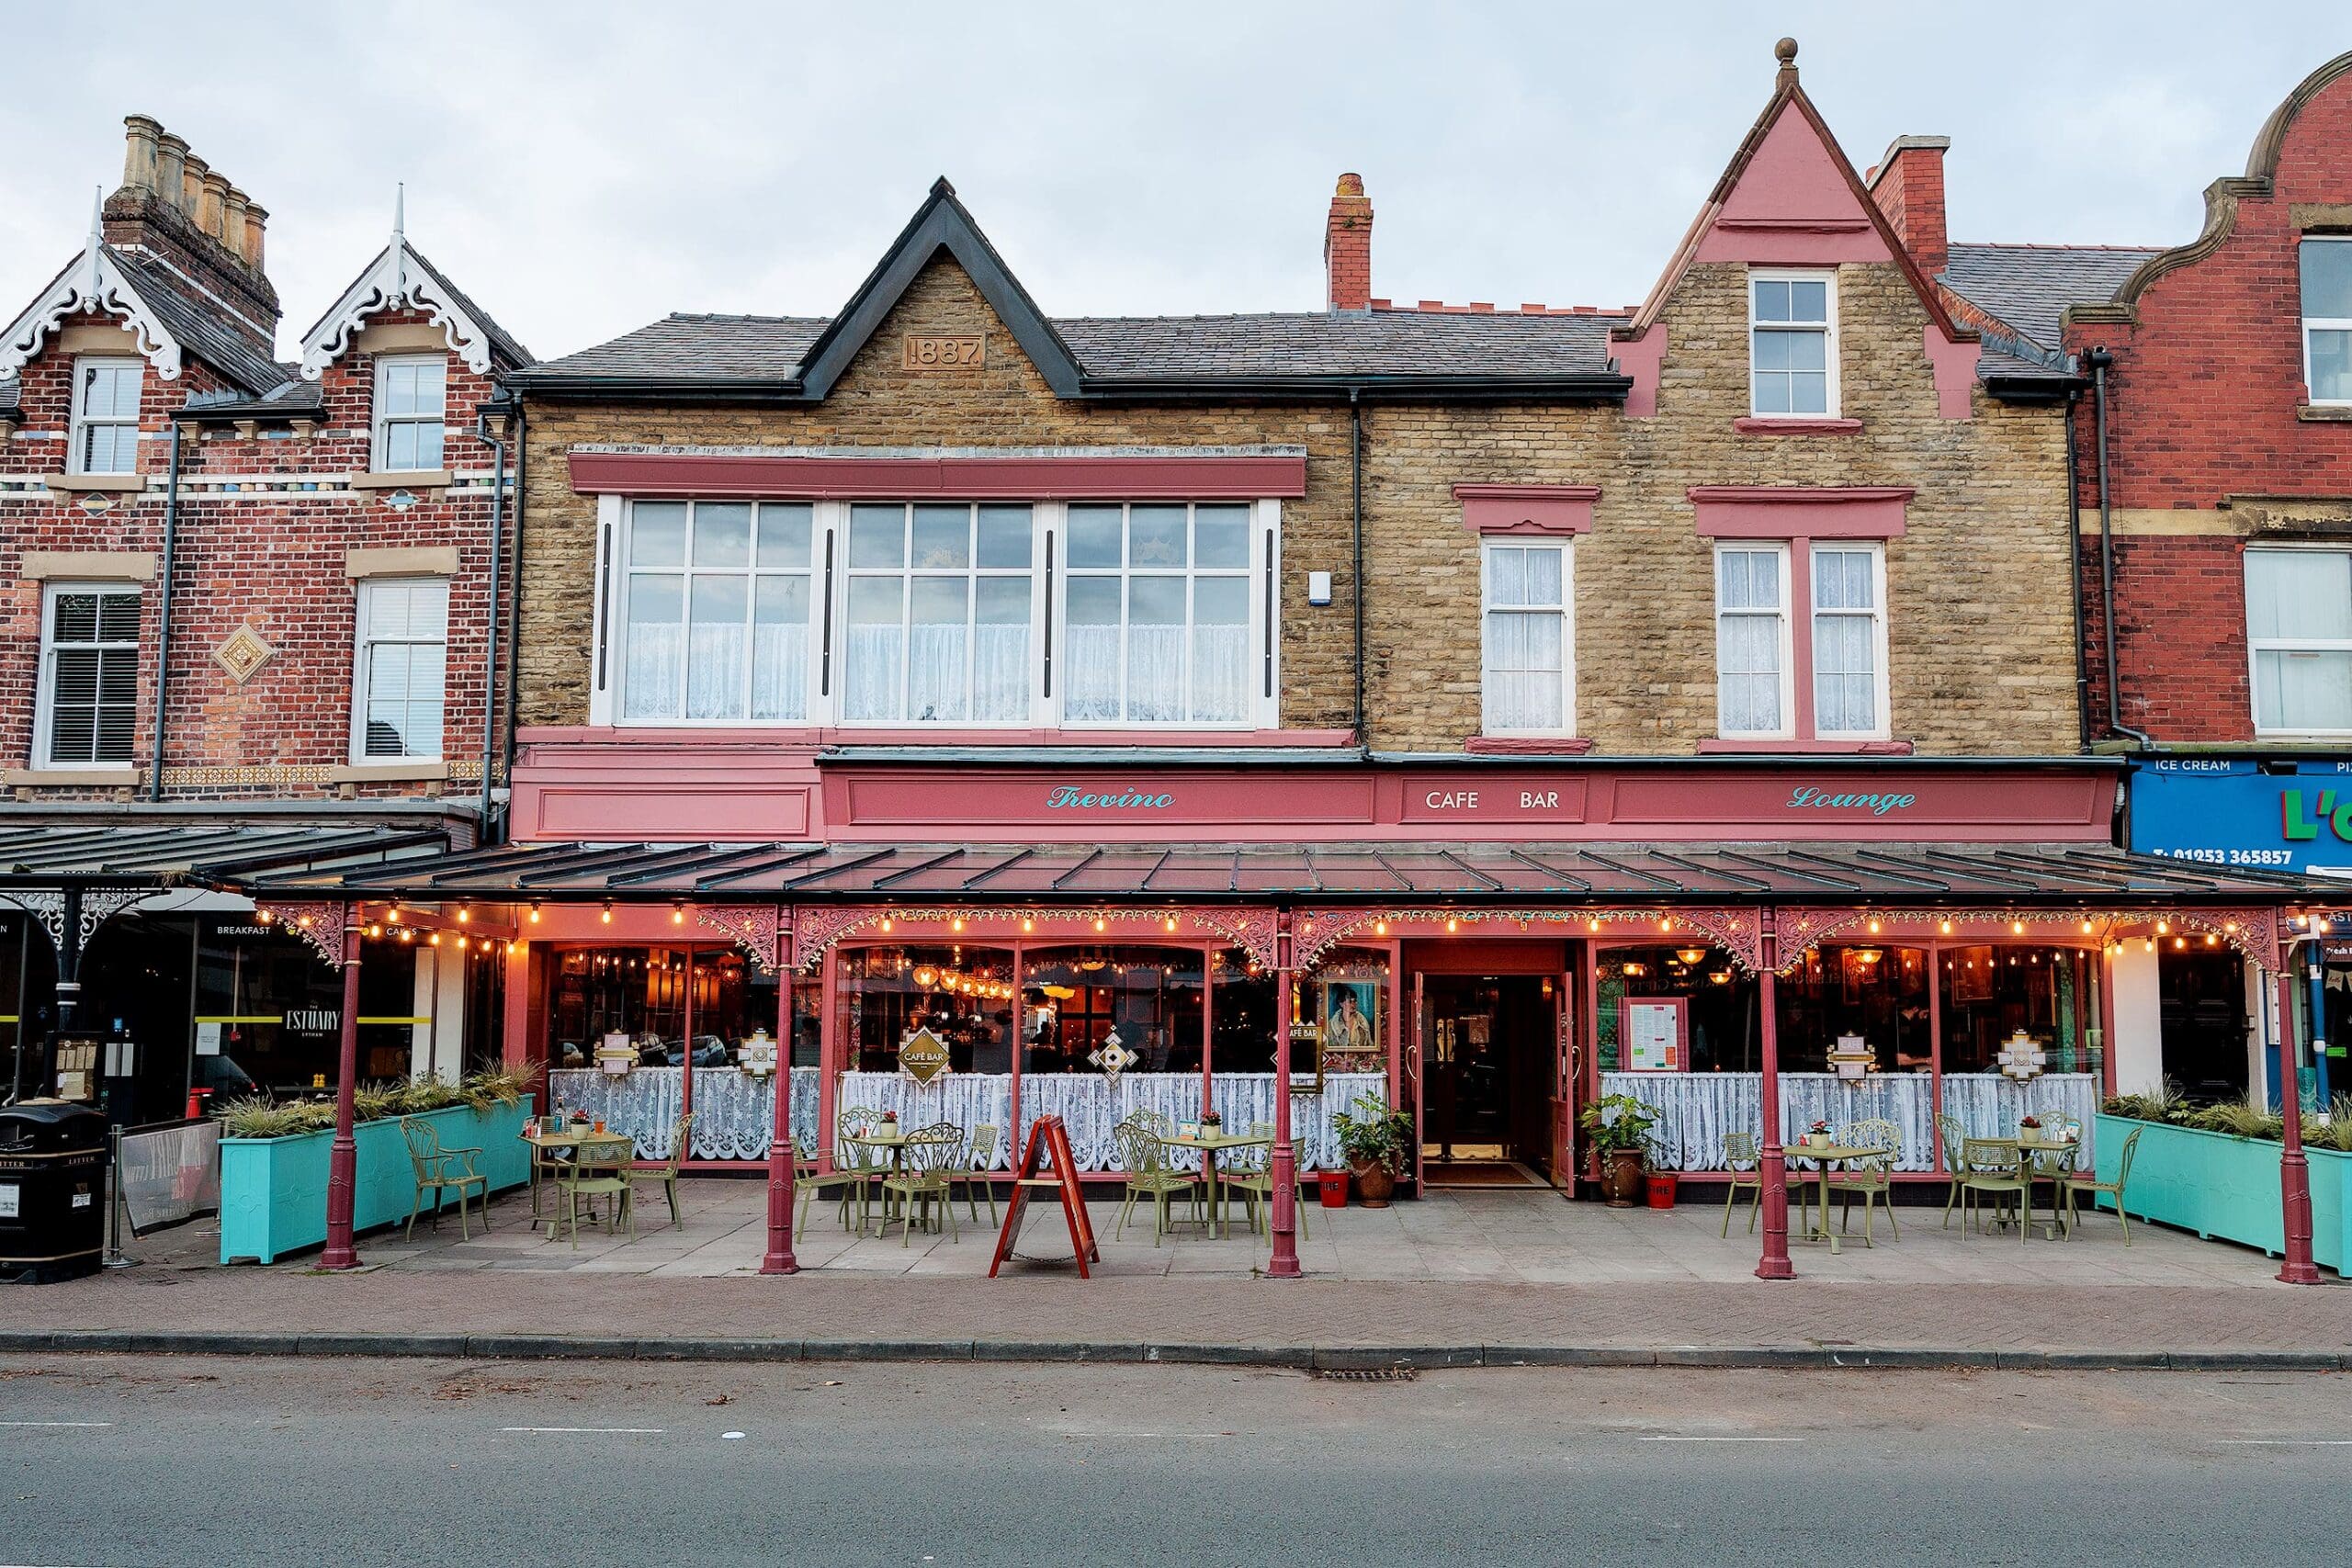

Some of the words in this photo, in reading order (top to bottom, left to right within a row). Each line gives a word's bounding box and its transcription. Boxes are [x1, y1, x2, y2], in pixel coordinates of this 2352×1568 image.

[2155, 760, 2177, 771] ICE
[2182, 760, 2231, 771] CREAM
[2336, 761, 2352, 773] PI
[1046, 785, 1177, 808] Trevino
[1425, 791, 1479, 809] CAFE
[1520, 791, 1559, 809] BAR
[1786, 785, 1917, 816] Lounge
[2229, 849, 2293, 865] 365857
[217, 926, 271, 935] BREAKFAST
[386, 927, 418, 936] CAKS
[287, 1010, 341, 1030] ESTUARY
[927, 1053, 944, 1061] BAR
